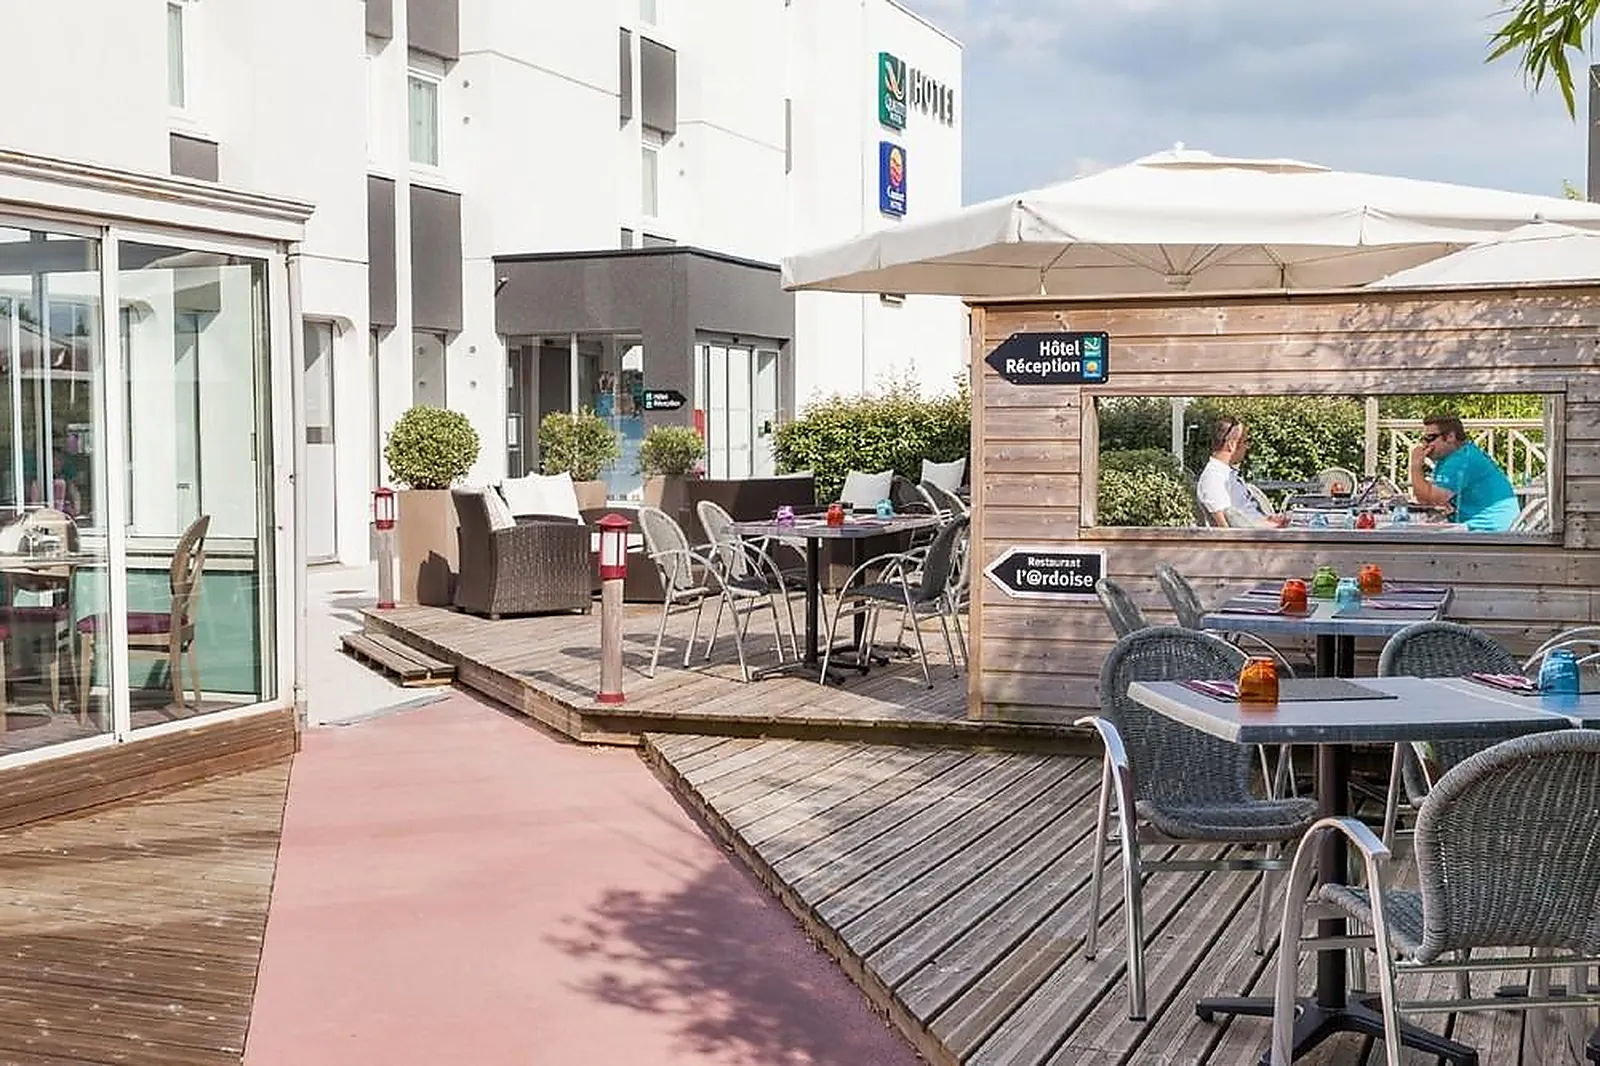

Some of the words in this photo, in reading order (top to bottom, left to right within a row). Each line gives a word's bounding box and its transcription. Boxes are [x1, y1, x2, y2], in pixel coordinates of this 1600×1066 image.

[909, 67, 954, 128] HOTEL
[1039, 340, 1080, 356] Hôtel
[1006, 358, 1080, 377] Réception
[1027, 557, 1081, 568] Restaurant
